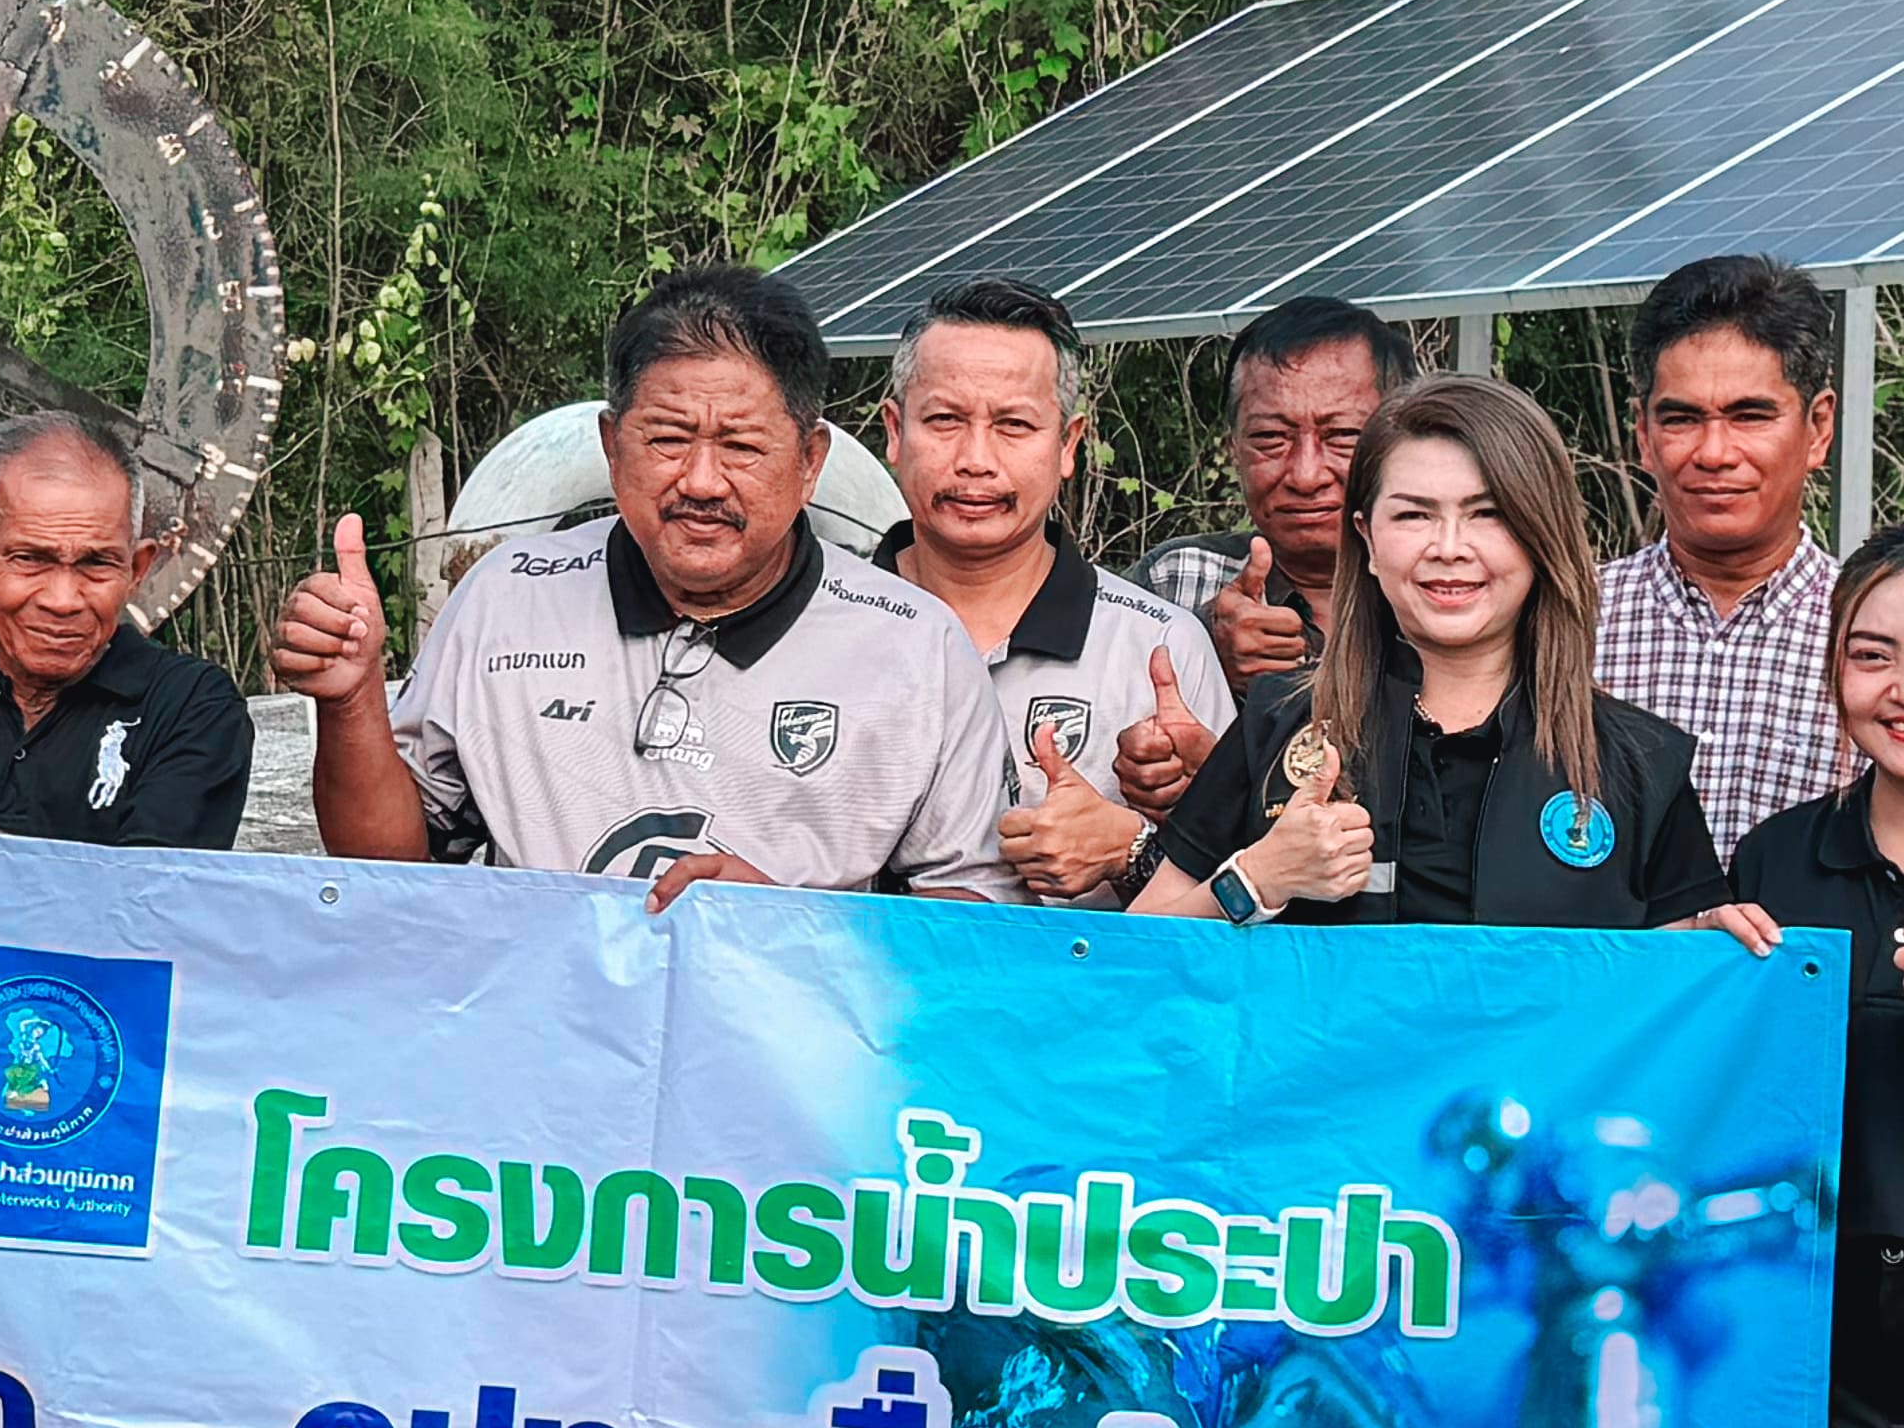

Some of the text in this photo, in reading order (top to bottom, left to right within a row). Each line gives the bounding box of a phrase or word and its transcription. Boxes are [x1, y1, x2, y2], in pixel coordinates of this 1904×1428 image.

[510, 548, 607, 577] 2GEAR
[539, 698, 597, 722] Ari
[64, 1196, 132, 1218] Authority
[246, 1087, 1450, 1330] โครงการน้ำประปา
